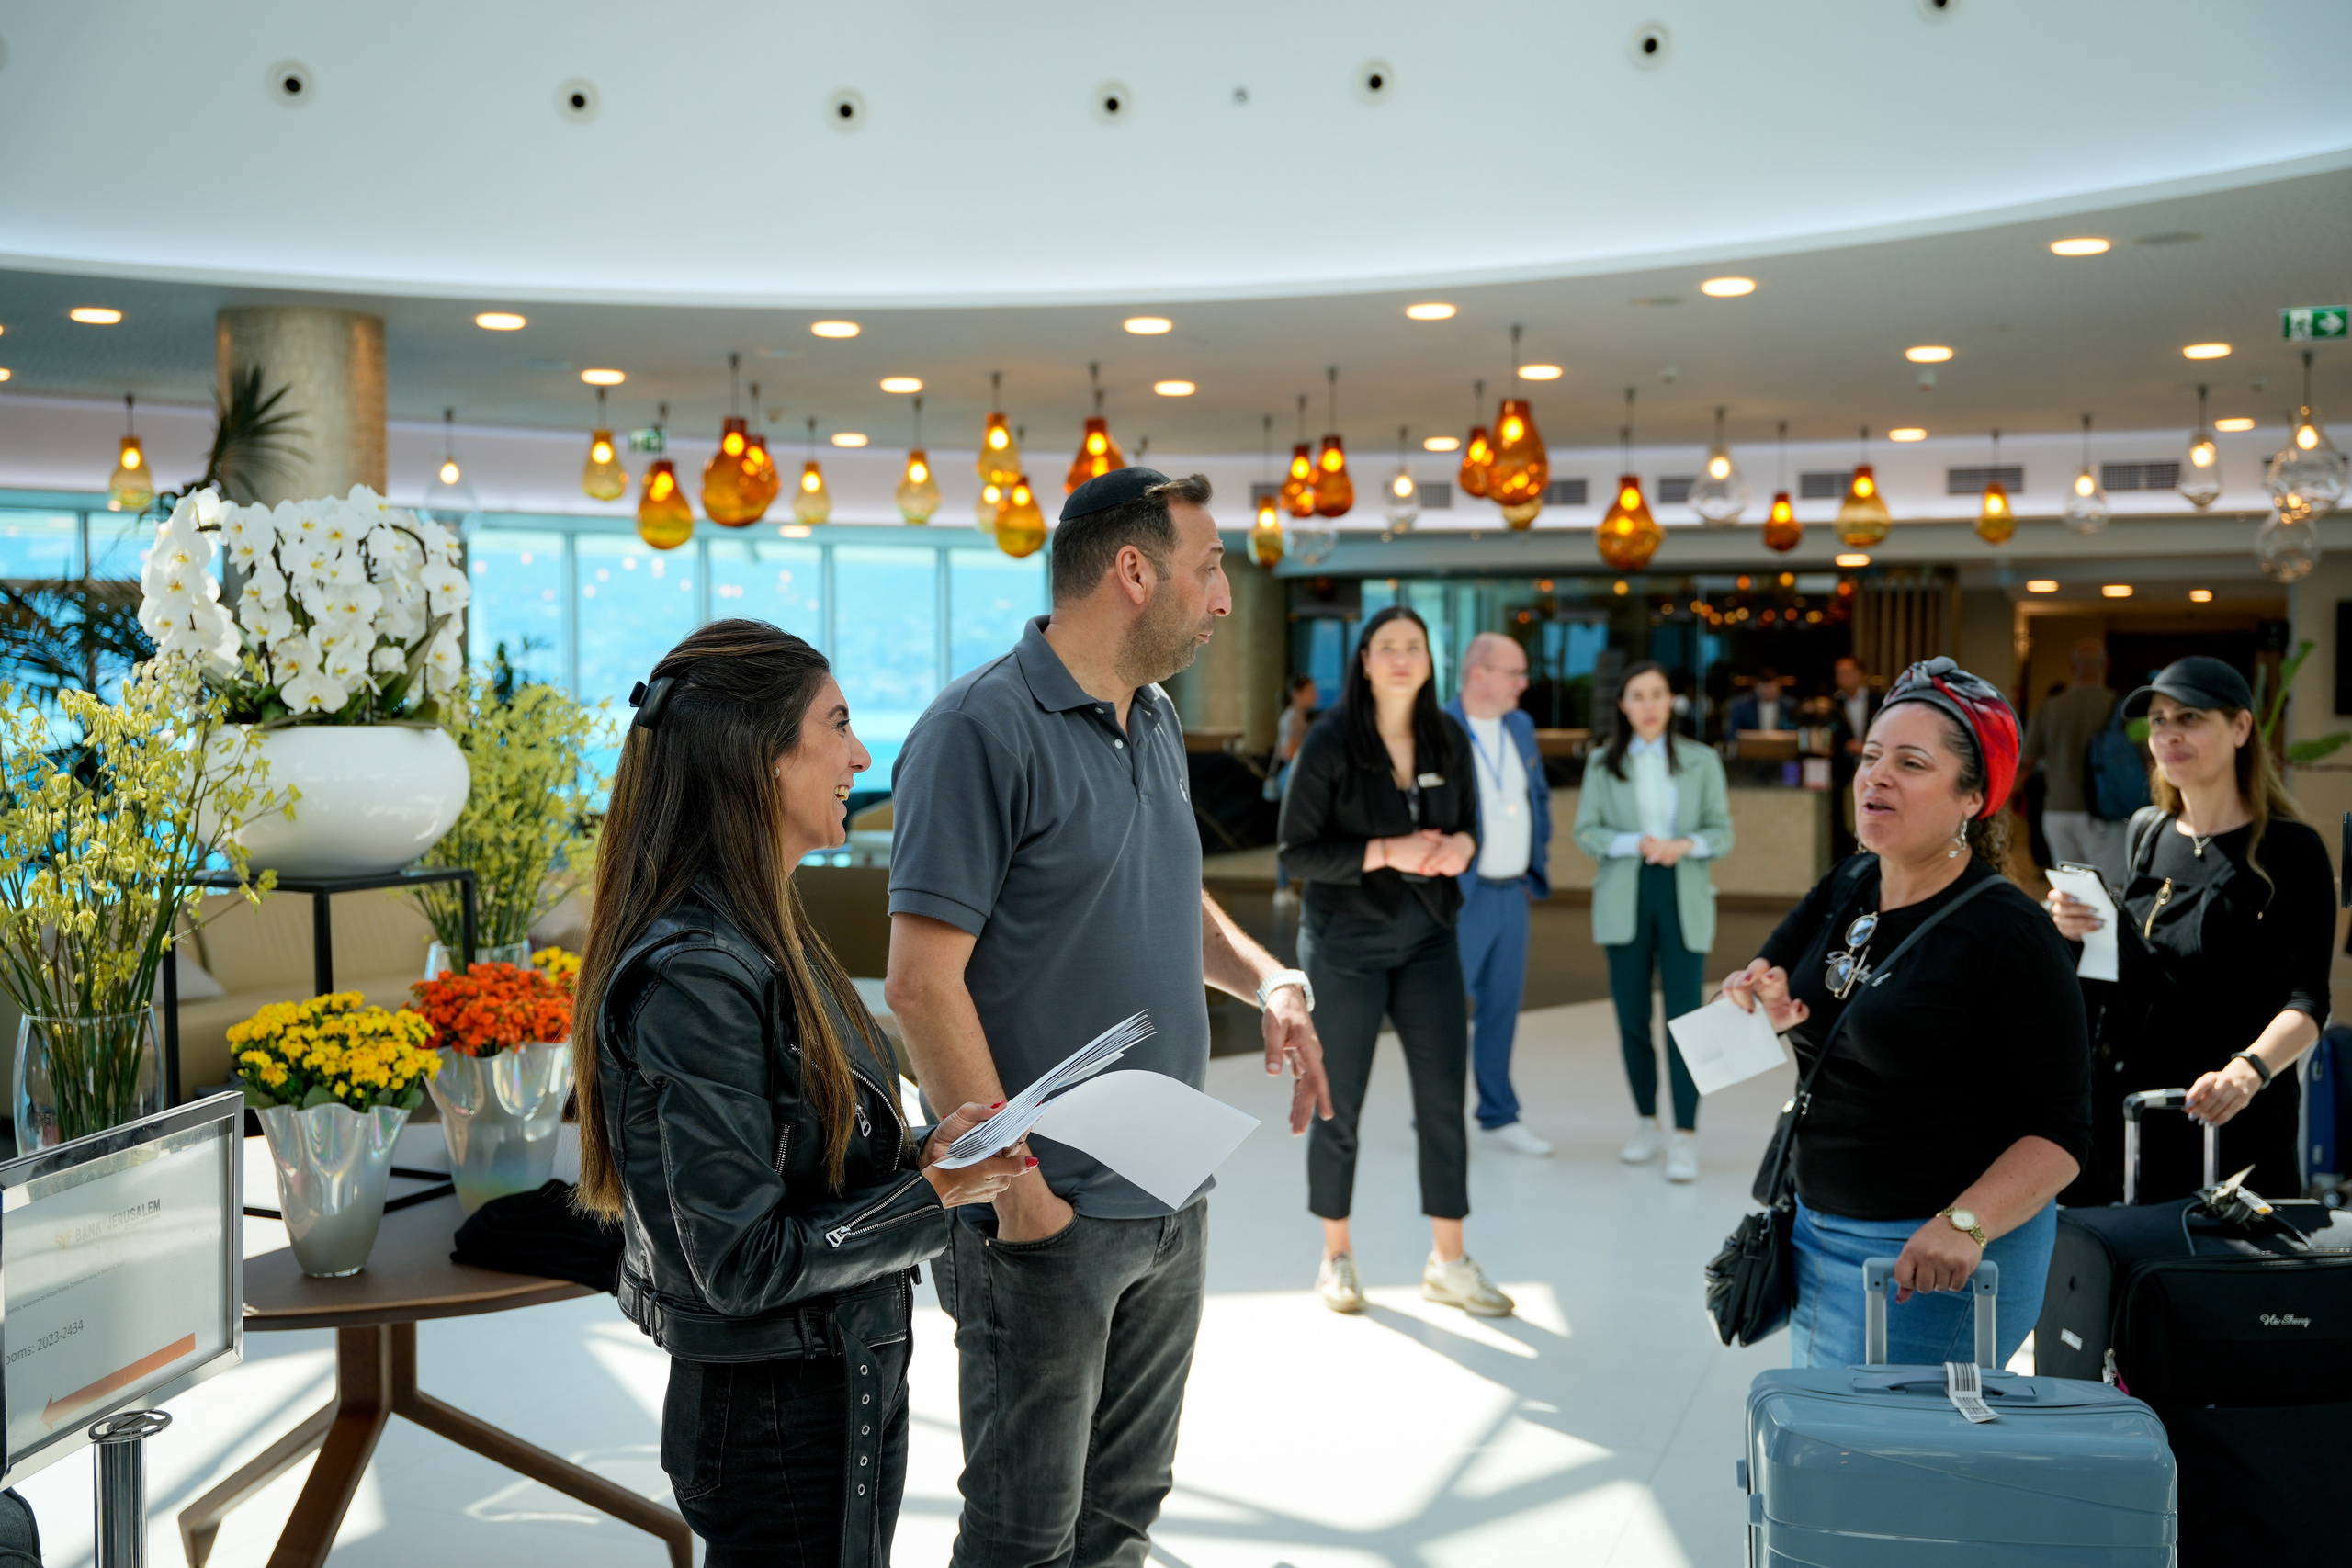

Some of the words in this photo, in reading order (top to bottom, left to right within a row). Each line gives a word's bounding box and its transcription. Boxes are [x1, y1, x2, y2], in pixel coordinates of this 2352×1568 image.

[75, 1220, 102, 1242] BANK
[107, 1198, 161, 1230] JERUSALEM
[37, 1319, 84, 1351] 2023-2434
